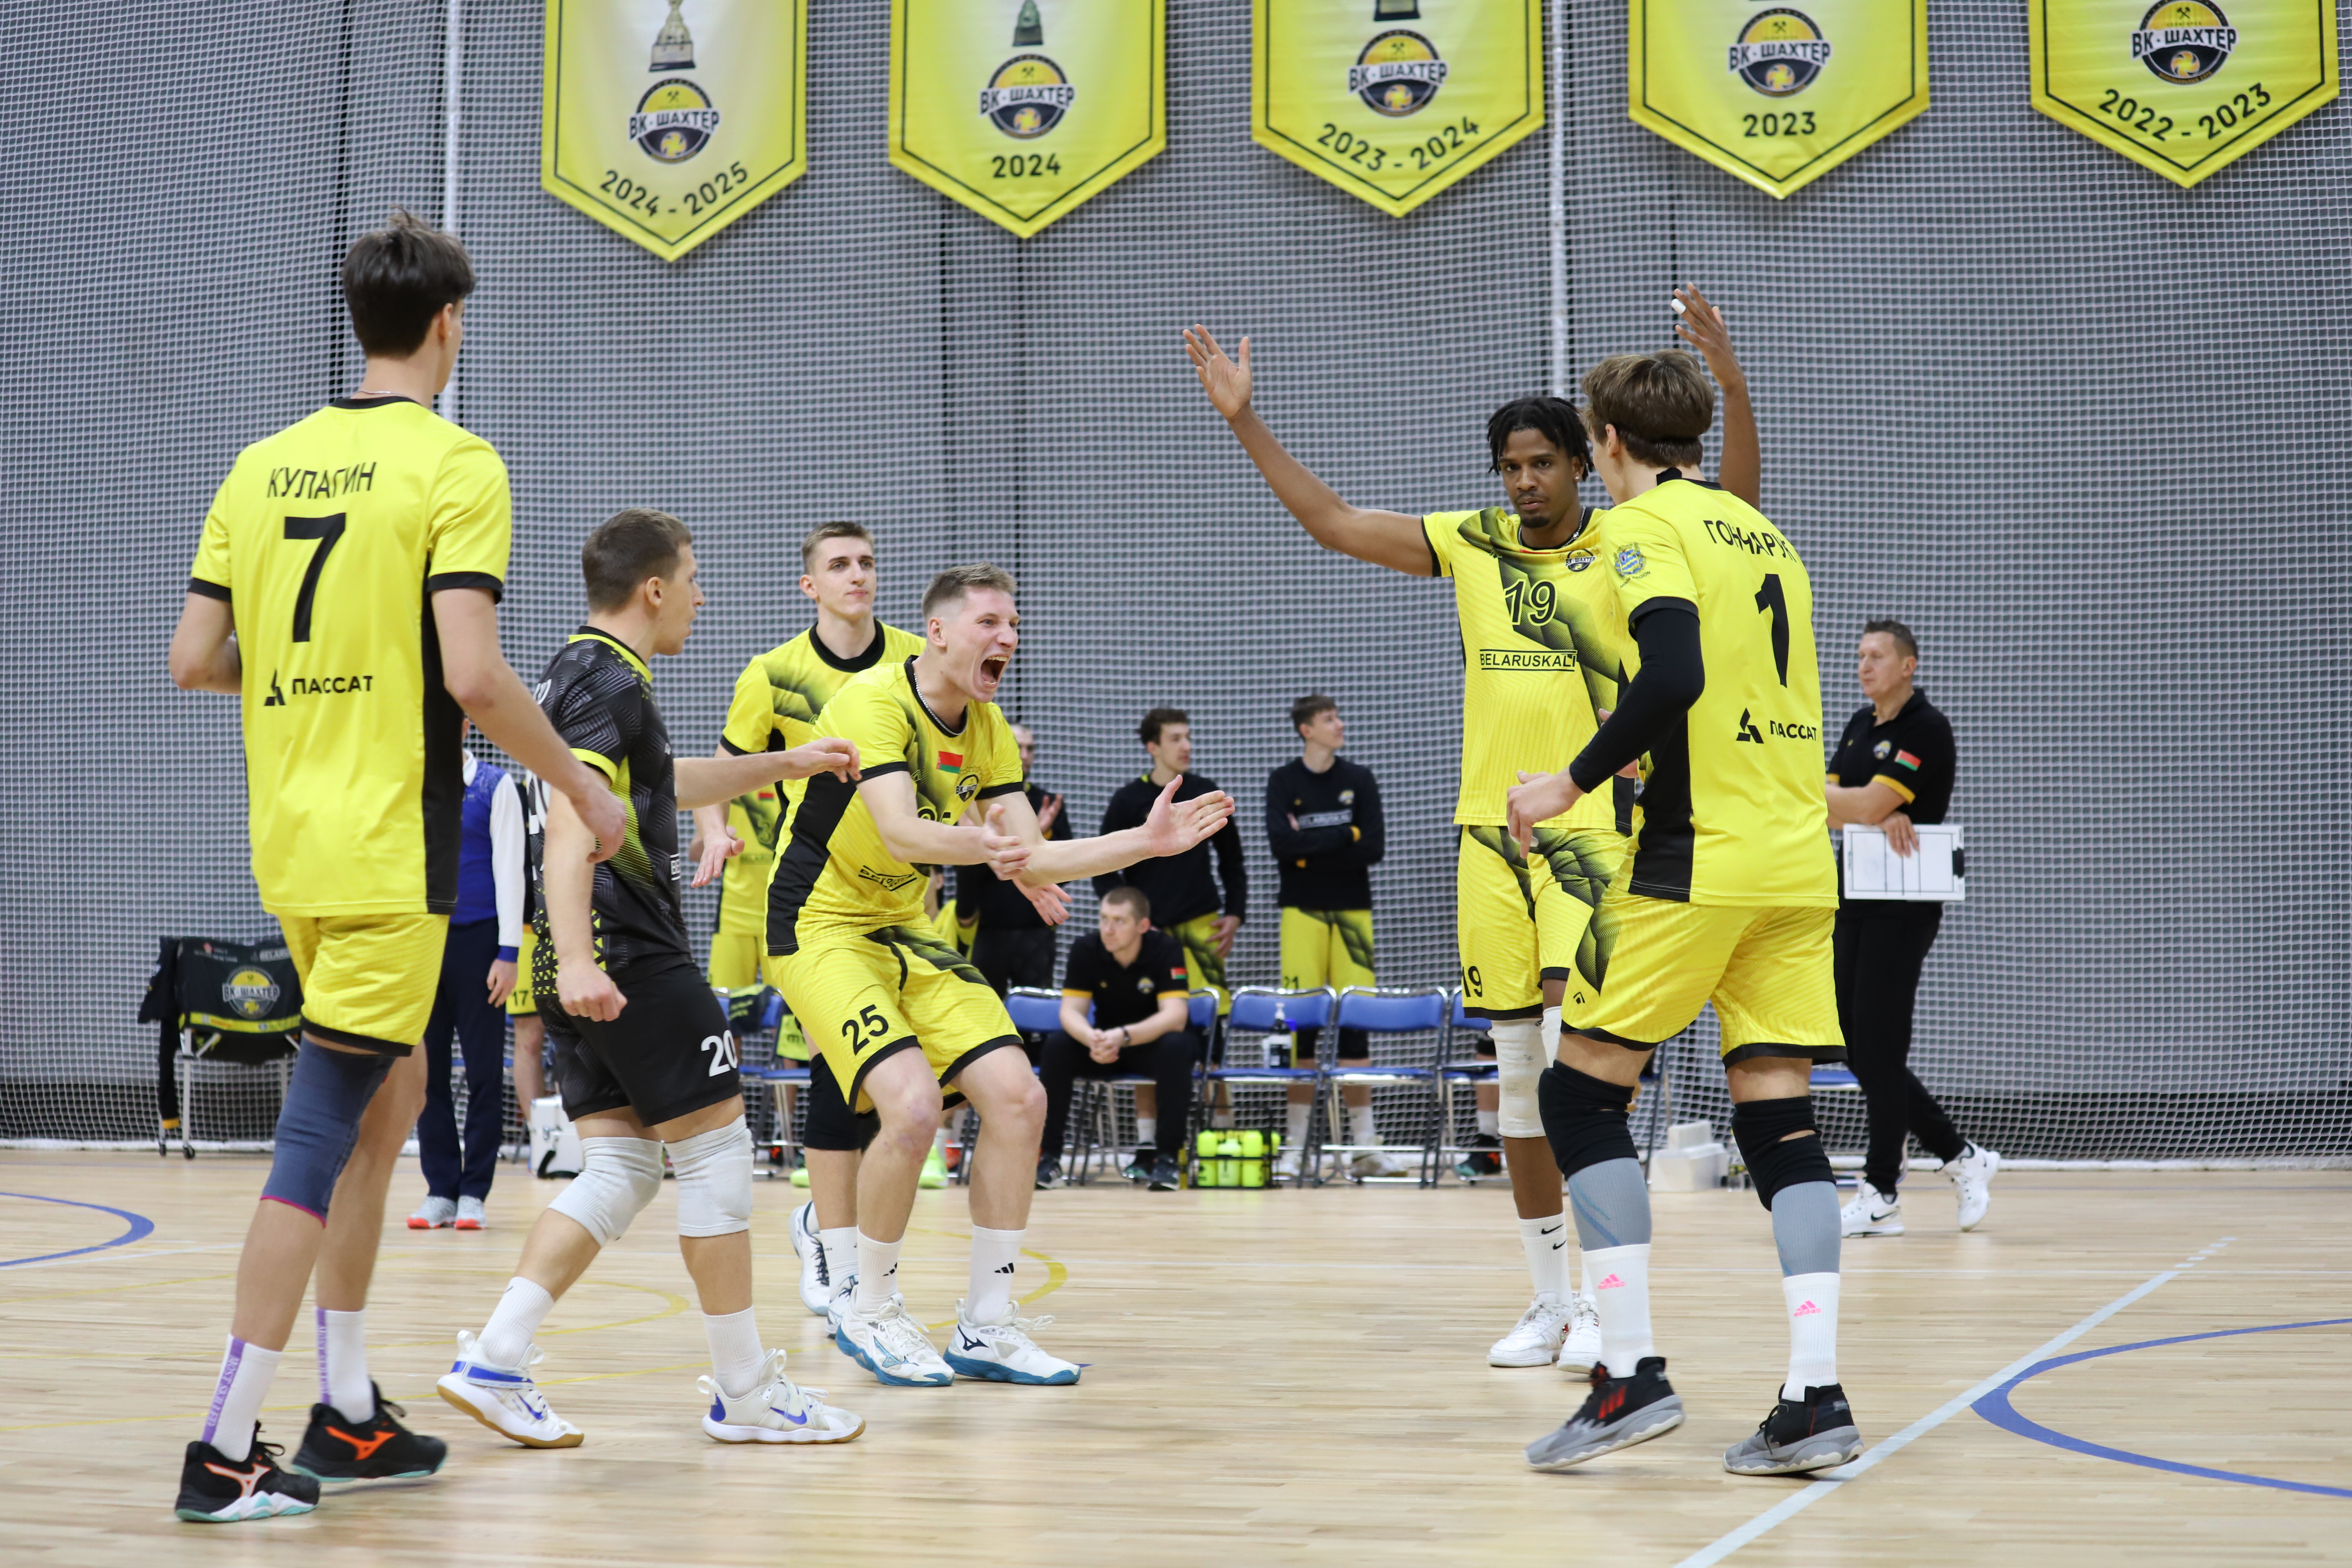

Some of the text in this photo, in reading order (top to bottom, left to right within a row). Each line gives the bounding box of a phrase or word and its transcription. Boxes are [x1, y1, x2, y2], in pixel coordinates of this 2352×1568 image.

[1743, 111, 1816, 137] 2023
[2099, 89, 2173, 142] 2022
[2199, 83, 2271, 140] 2023
[1318, 123, 1386, 171] 2023
[1410, 116, 1479, 170] 2024
[992, 153, 1061, 178] 2024
[600, 170, 658, 216] 2024
[684, 162, 748, 216] 2025
[267, 462, 377, 499] КУЛАГИН
[284, 512, 346, 643] 7
[1620, 577, 1631, 588] MINSK
[1504, 579, 1557, 626] 19
[1755, 574, 1790, 688] 1
[1480, 653, 1576, 668] BELARUSKALI
[292, 675, 373, 695] ПАССАТ
[1770, 720, 1817, 741] ПАССАТ
[513, 990, 529, 1007] 17
[1462, 966, 1482, 997] 19
[842, 1004, 889, 1055] 25
[700, 1030, 738, 1077] 20
[1794, 1308, 1822, 1317] adidas
